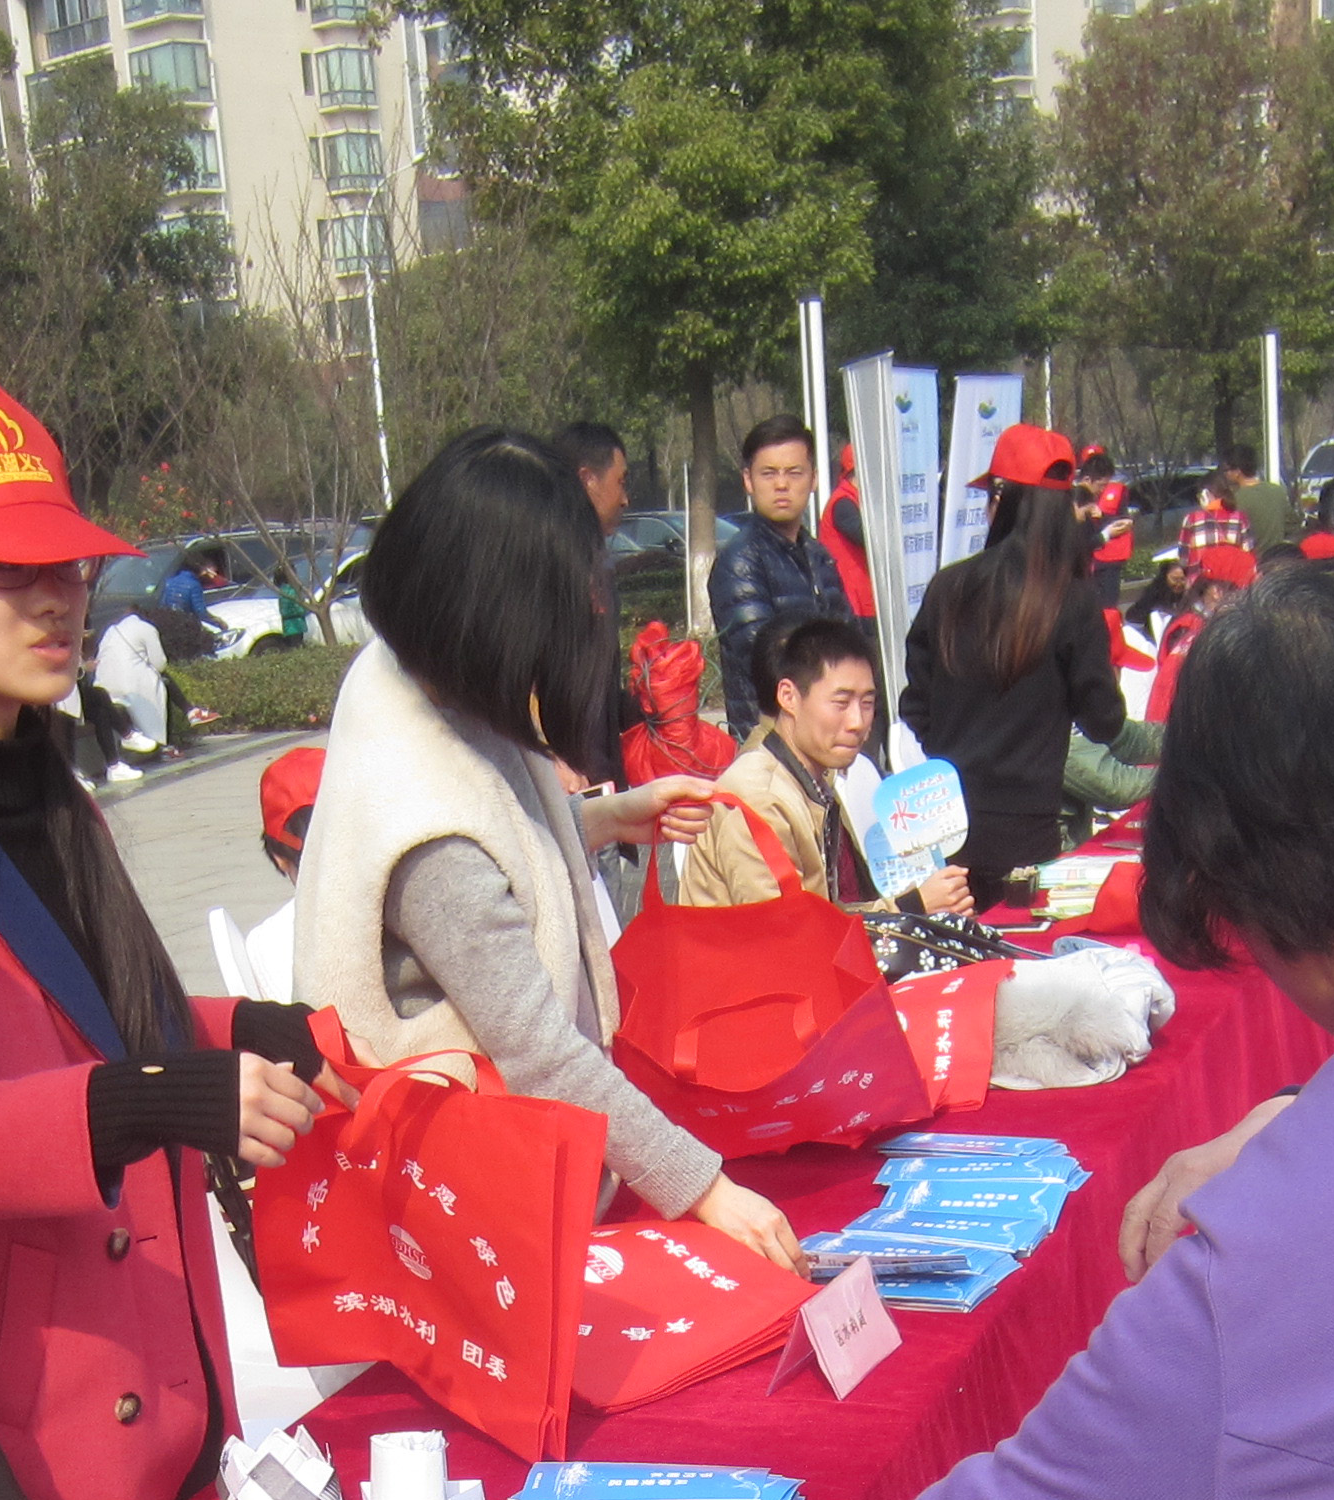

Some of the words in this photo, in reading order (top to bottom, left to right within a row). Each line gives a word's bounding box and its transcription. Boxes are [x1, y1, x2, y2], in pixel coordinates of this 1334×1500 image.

[889, 799, 919, 832] 水
[333, 1292, 437, 1345] 滨湖水利
[461, 1339, 508, 1382] 团委
